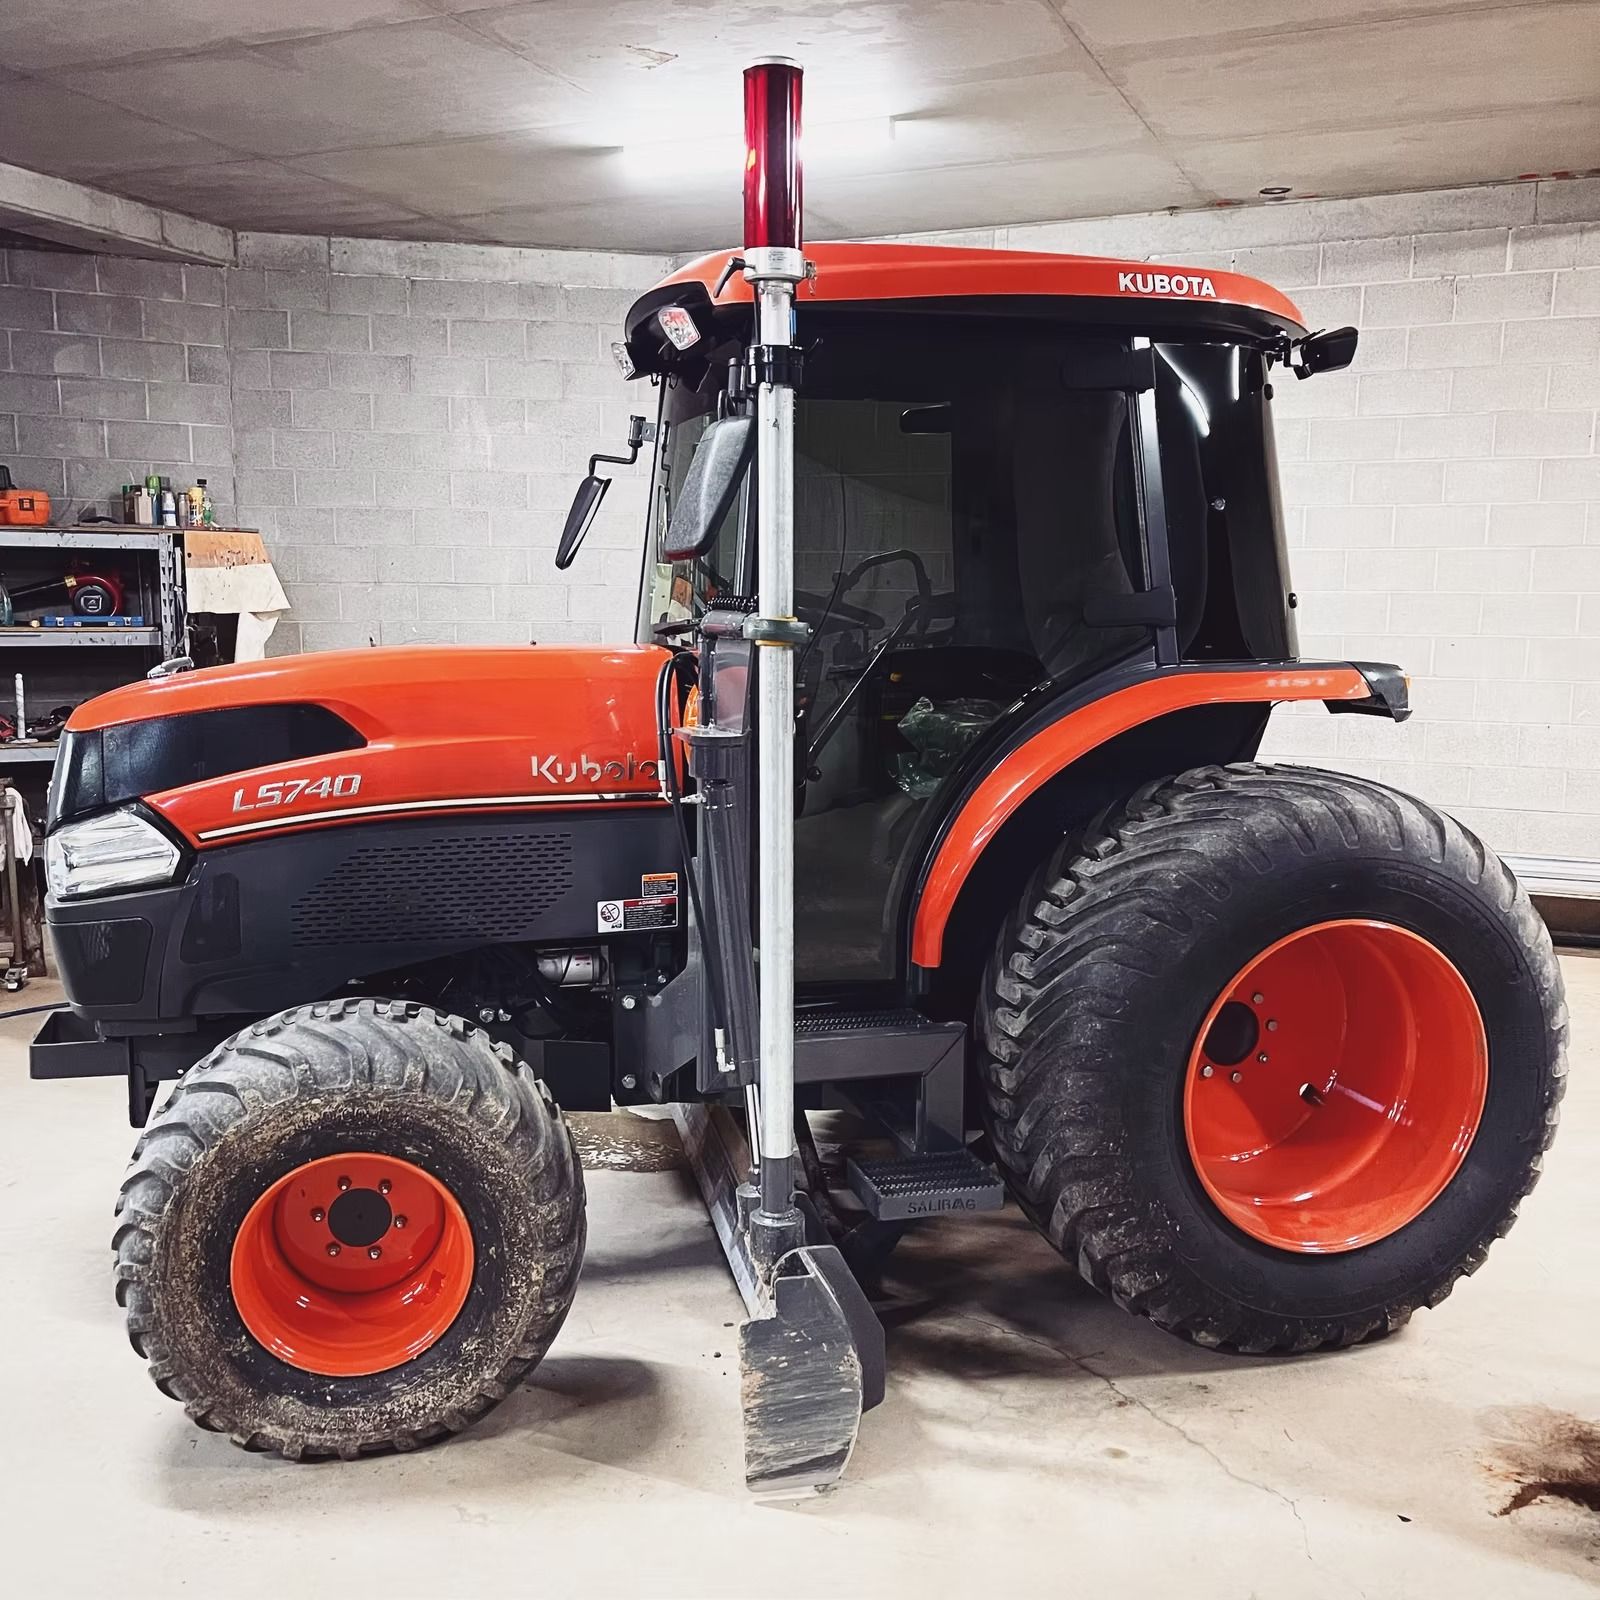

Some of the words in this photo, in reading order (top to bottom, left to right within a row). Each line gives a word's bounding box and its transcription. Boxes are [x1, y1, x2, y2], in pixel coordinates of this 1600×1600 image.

[1118, 272, 1216, 297] KUBOTA
[530, 752, 658, 783] Kubota
[233, 773, 361, 812] LS740
